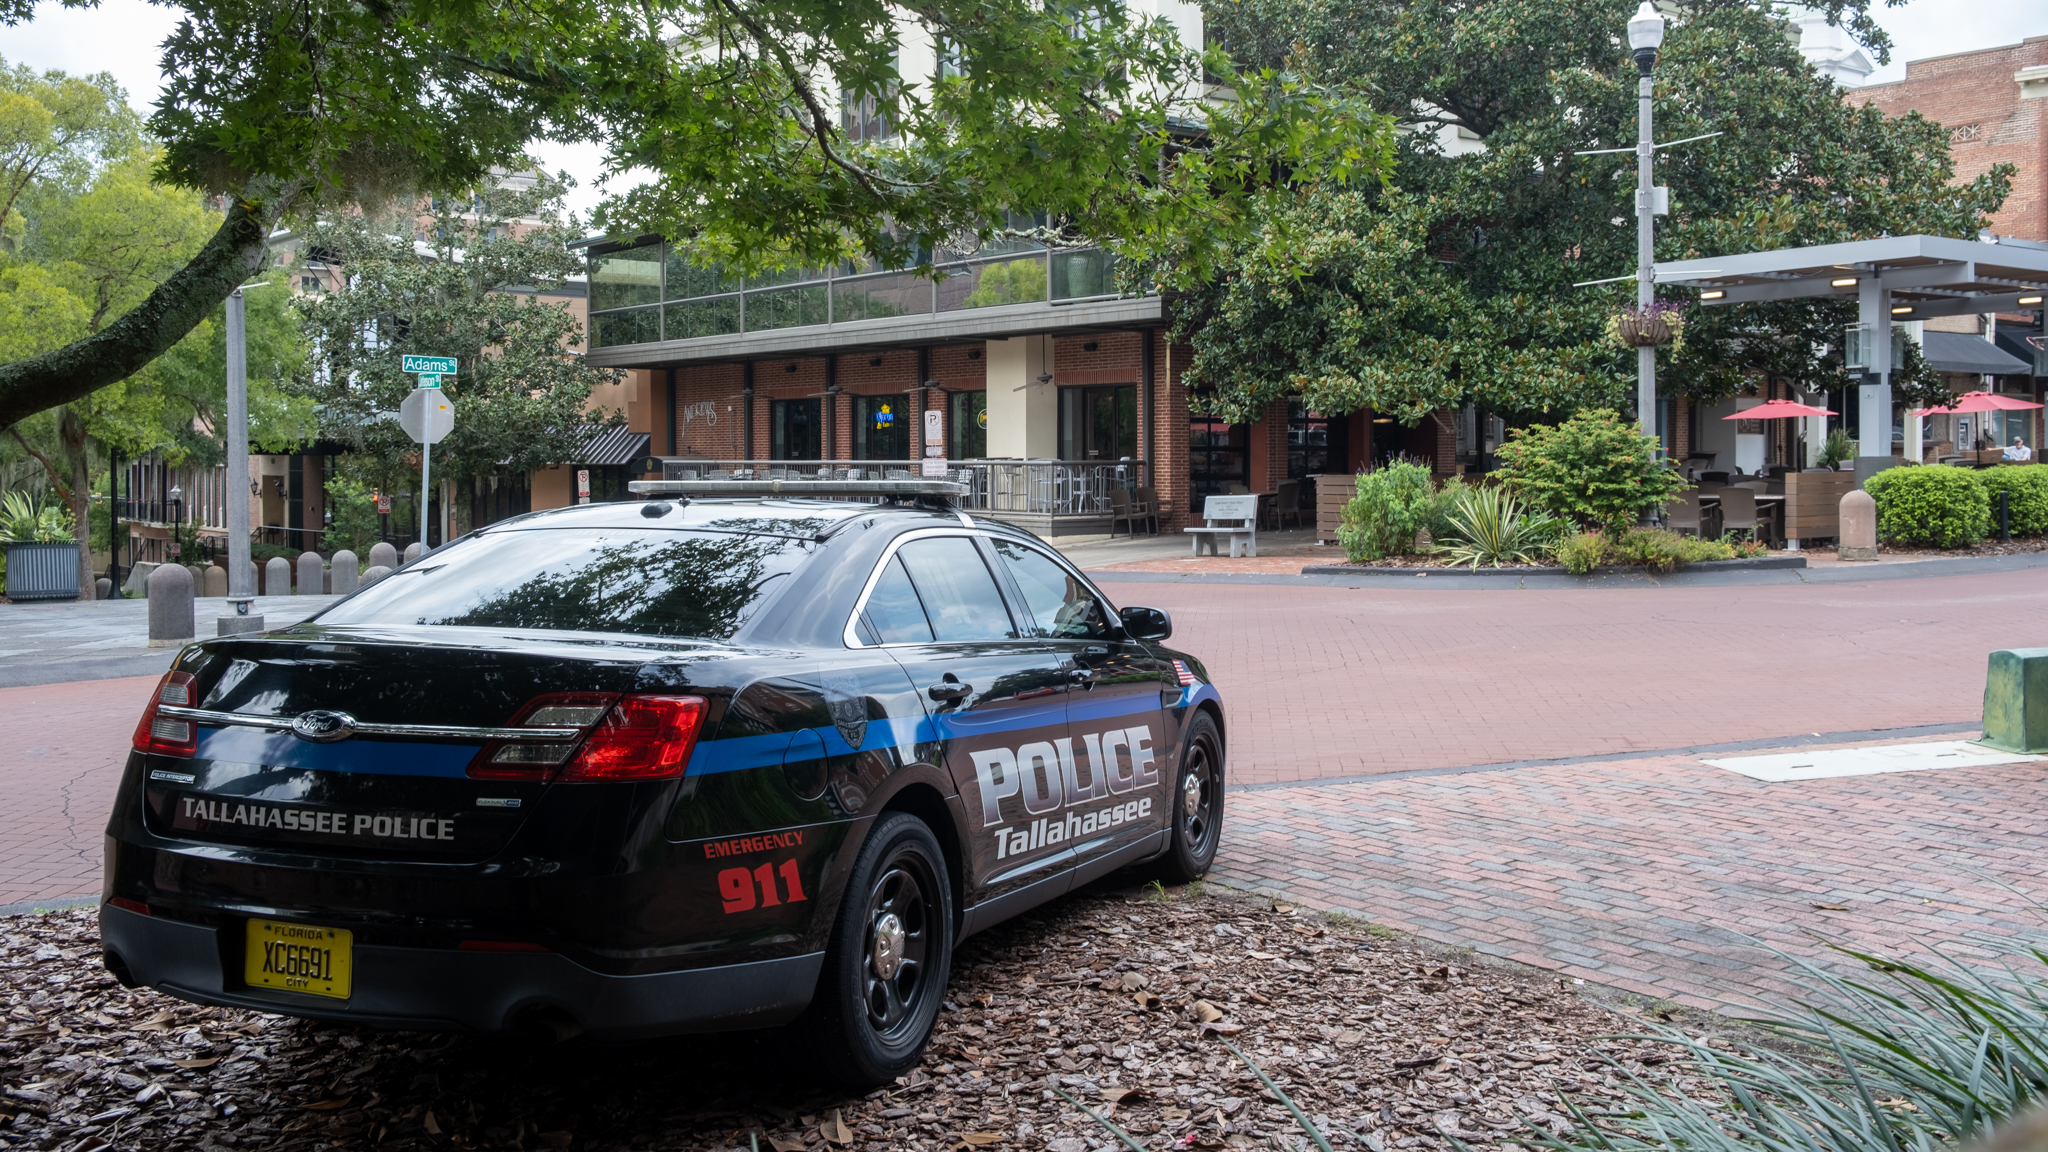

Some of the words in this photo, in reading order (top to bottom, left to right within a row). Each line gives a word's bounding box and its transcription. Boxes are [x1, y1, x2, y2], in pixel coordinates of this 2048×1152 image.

[405, 357, 448, 372] Adams
[302, 714, 333, 731] Ford
[969, 724, 1159, 828] POLICE
[183, 797, 347, 834] TALLAHASSEE
[353, 814, 455, 840] POLICE
[994, 797, 1152, 860] Tallahassee
[703, 830, 803, 859] EMERGENCY
[717, 858, 808, 914] 911
[274, 925, 323, 941] FLORIDA
[262, 940, 333, 982] XC6691
[286, 977, 309, 989] CITY
